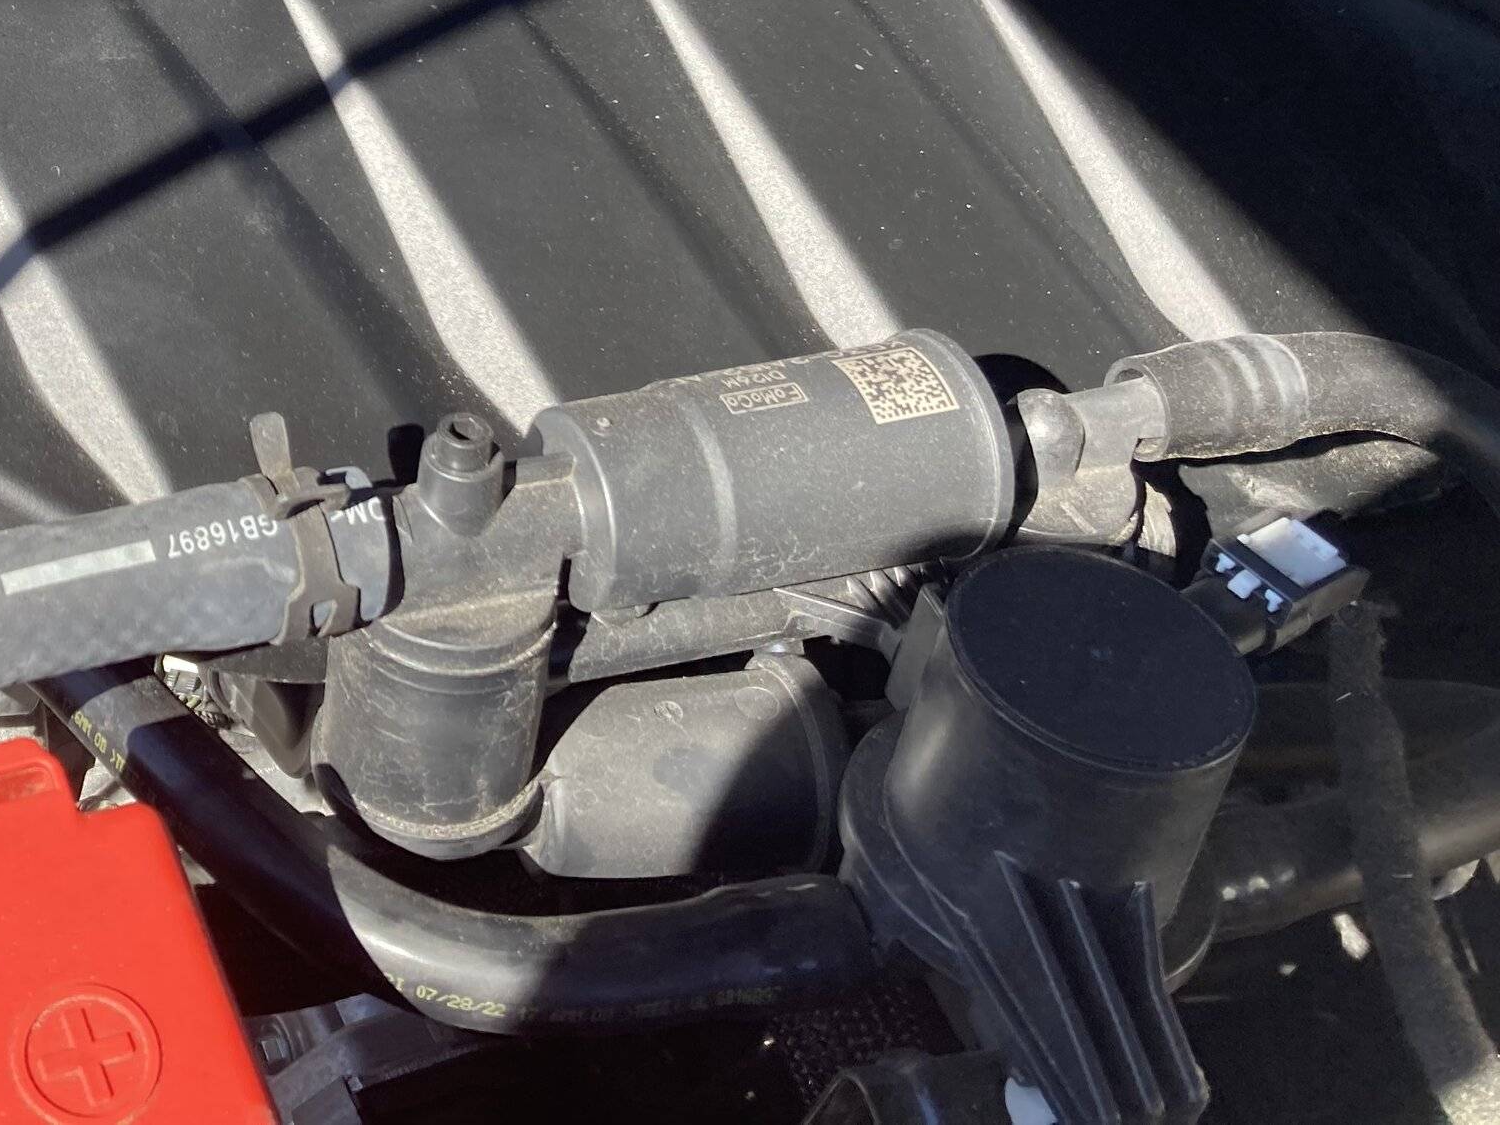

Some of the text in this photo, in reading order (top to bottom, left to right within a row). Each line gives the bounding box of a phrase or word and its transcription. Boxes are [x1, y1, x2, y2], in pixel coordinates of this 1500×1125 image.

[725, 387, 802, 409] FoMoCo
[167, 512, 279, 560] GB16897
[415, 984, 507, 1017] 07/28/22
